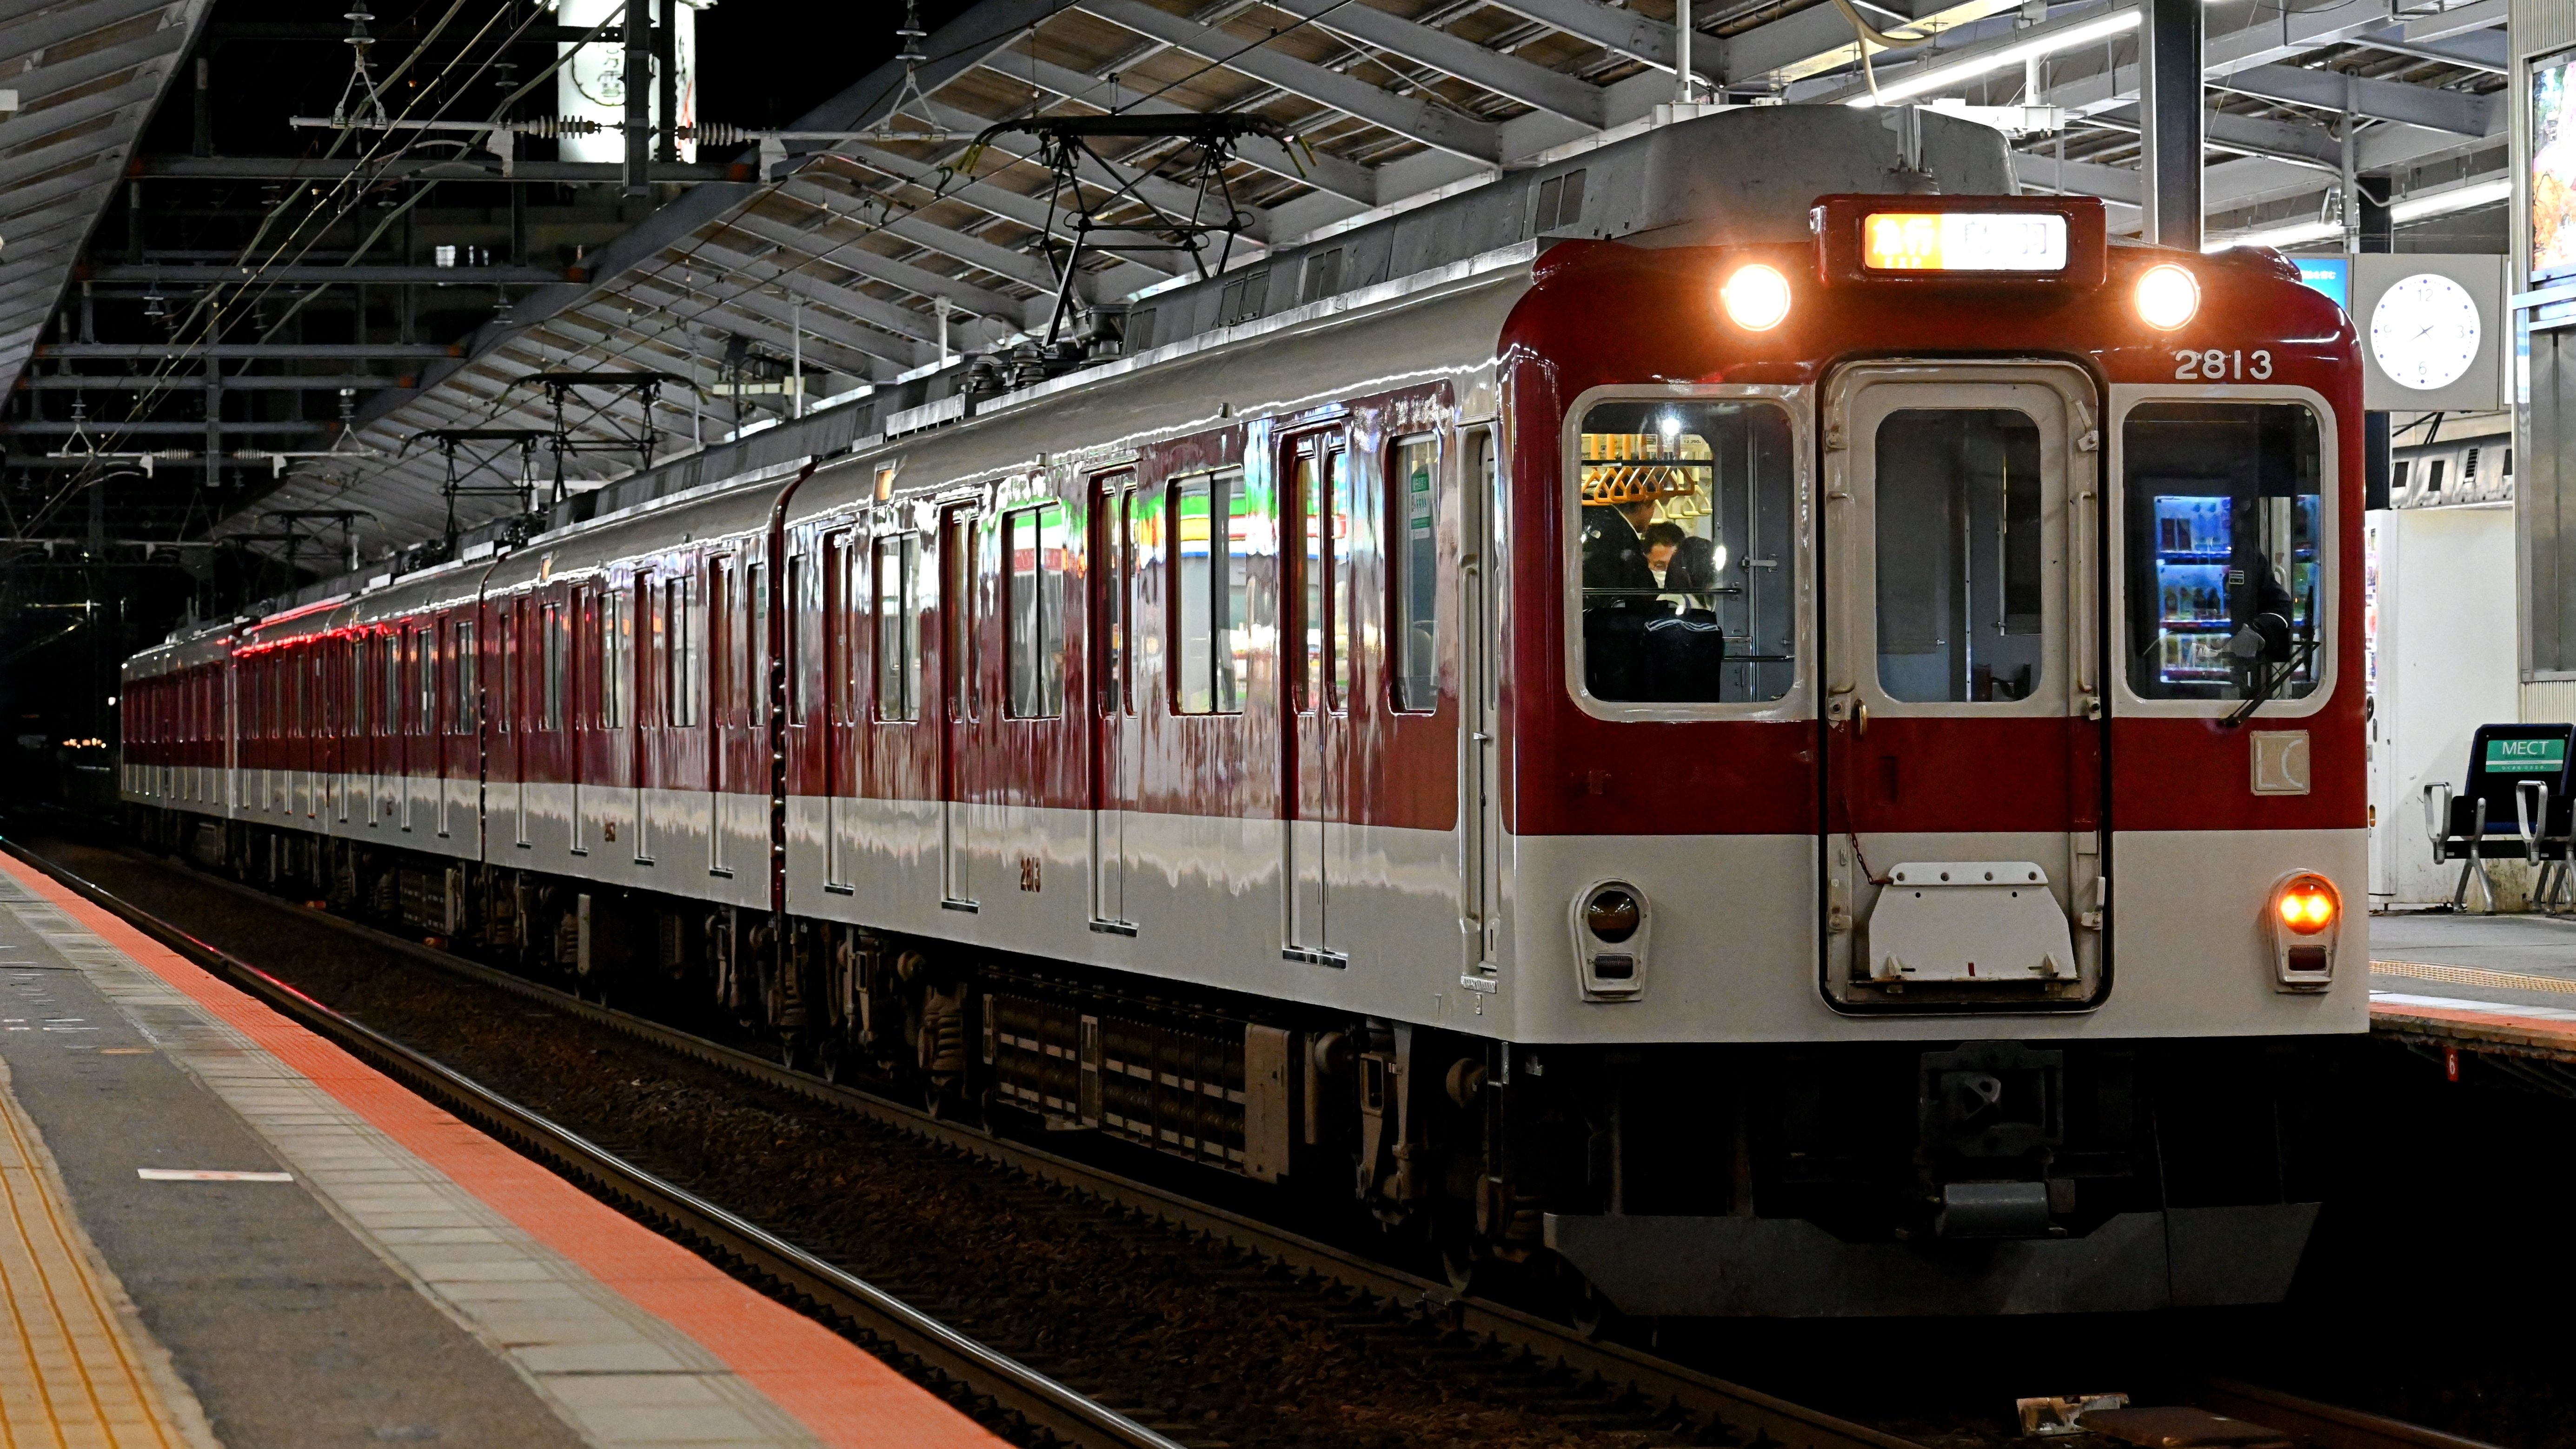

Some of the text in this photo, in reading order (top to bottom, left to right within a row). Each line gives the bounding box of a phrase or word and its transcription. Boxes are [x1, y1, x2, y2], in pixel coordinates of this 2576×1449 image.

[2417, 288, 2433, 302] 12
[2456, 325, 2464, 339] 3
[2175, 349, 2272, 379] 2813
[2418, 361, 2427, 375] 6
[2502, 741, 2549, 755] MECT
[1020, 857, 1041, 893] 2813
[2449, 1054, 2456, 1075] 6
